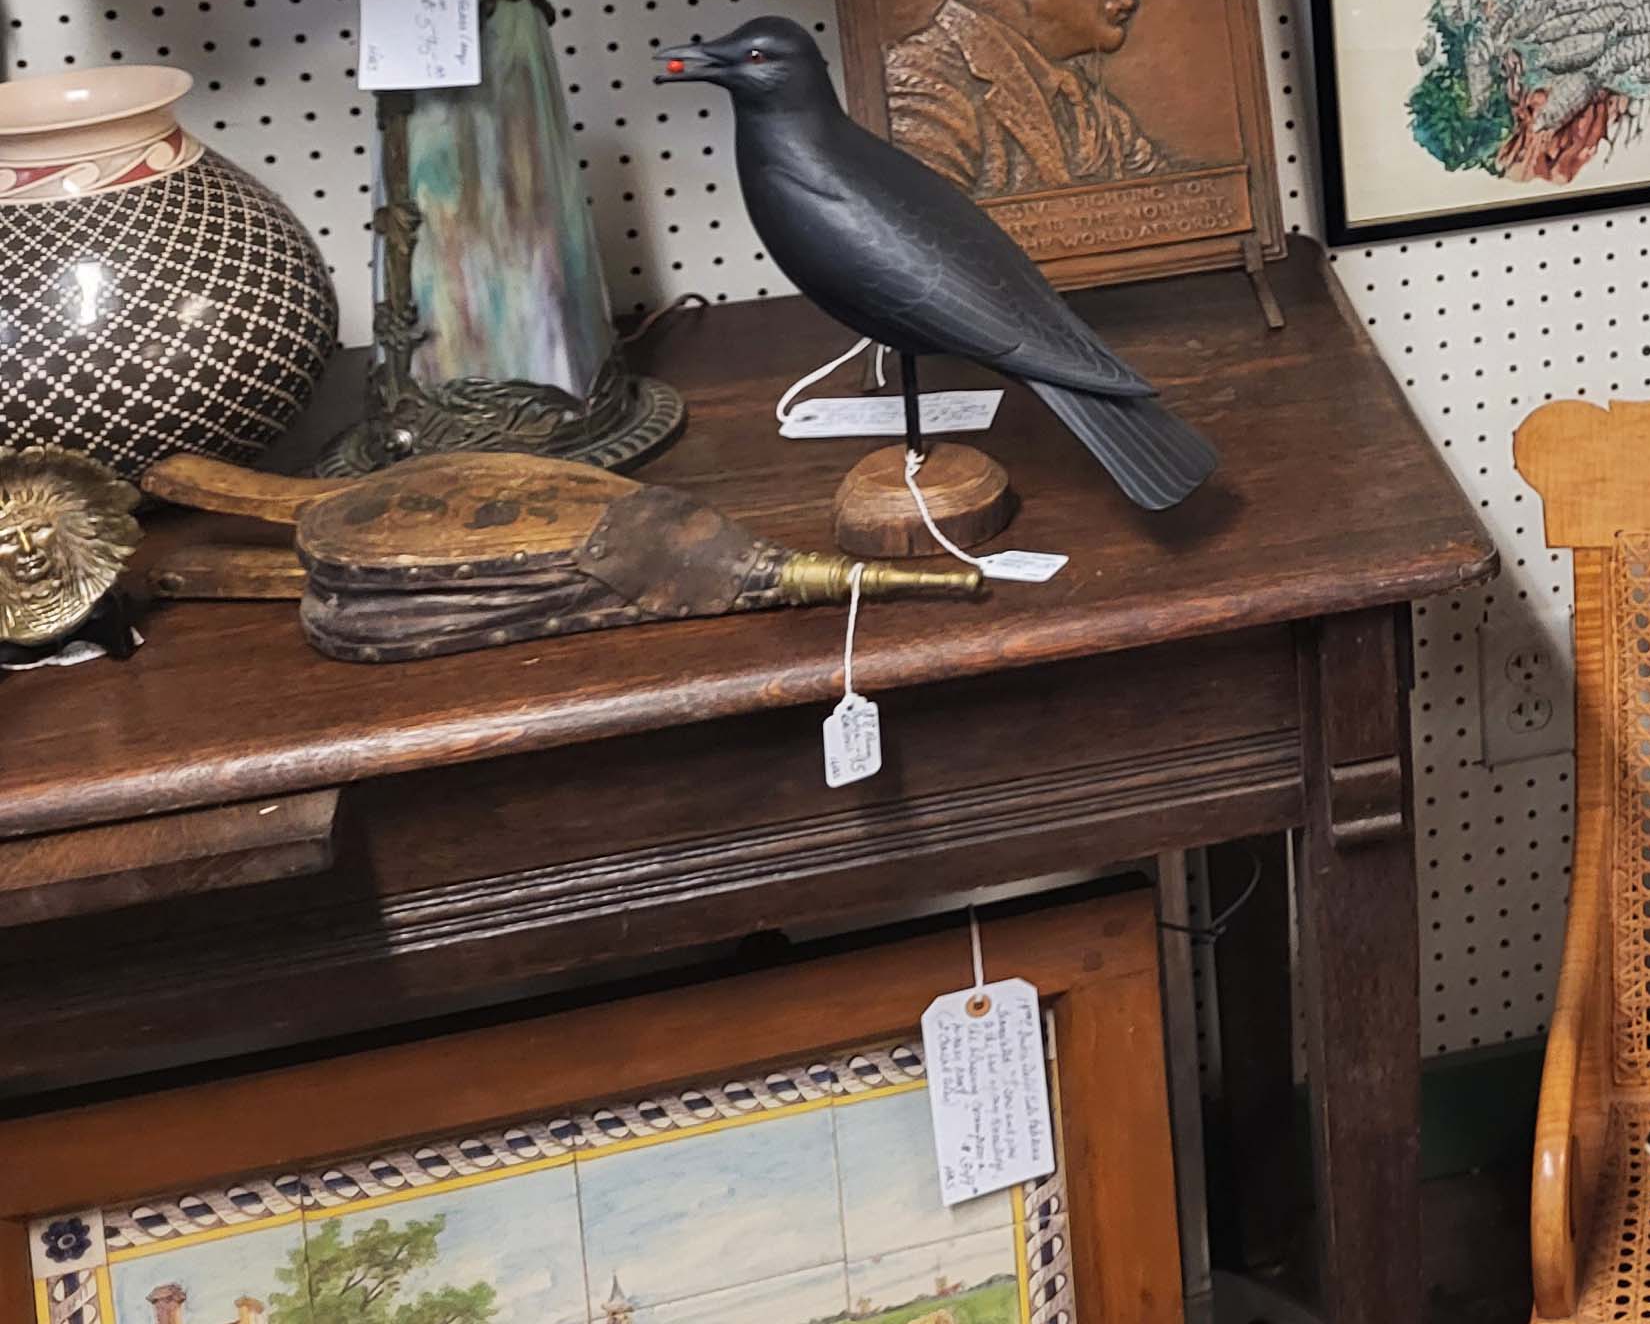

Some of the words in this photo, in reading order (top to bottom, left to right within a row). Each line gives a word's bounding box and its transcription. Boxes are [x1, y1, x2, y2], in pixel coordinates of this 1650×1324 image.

[1069, 186, 1166, 208] FIGHTING
[1173, 179, 1217, 197] FOR
[1072, 210, 1122, 228] THE
[1059, 226, 1135, 248] WORLD
